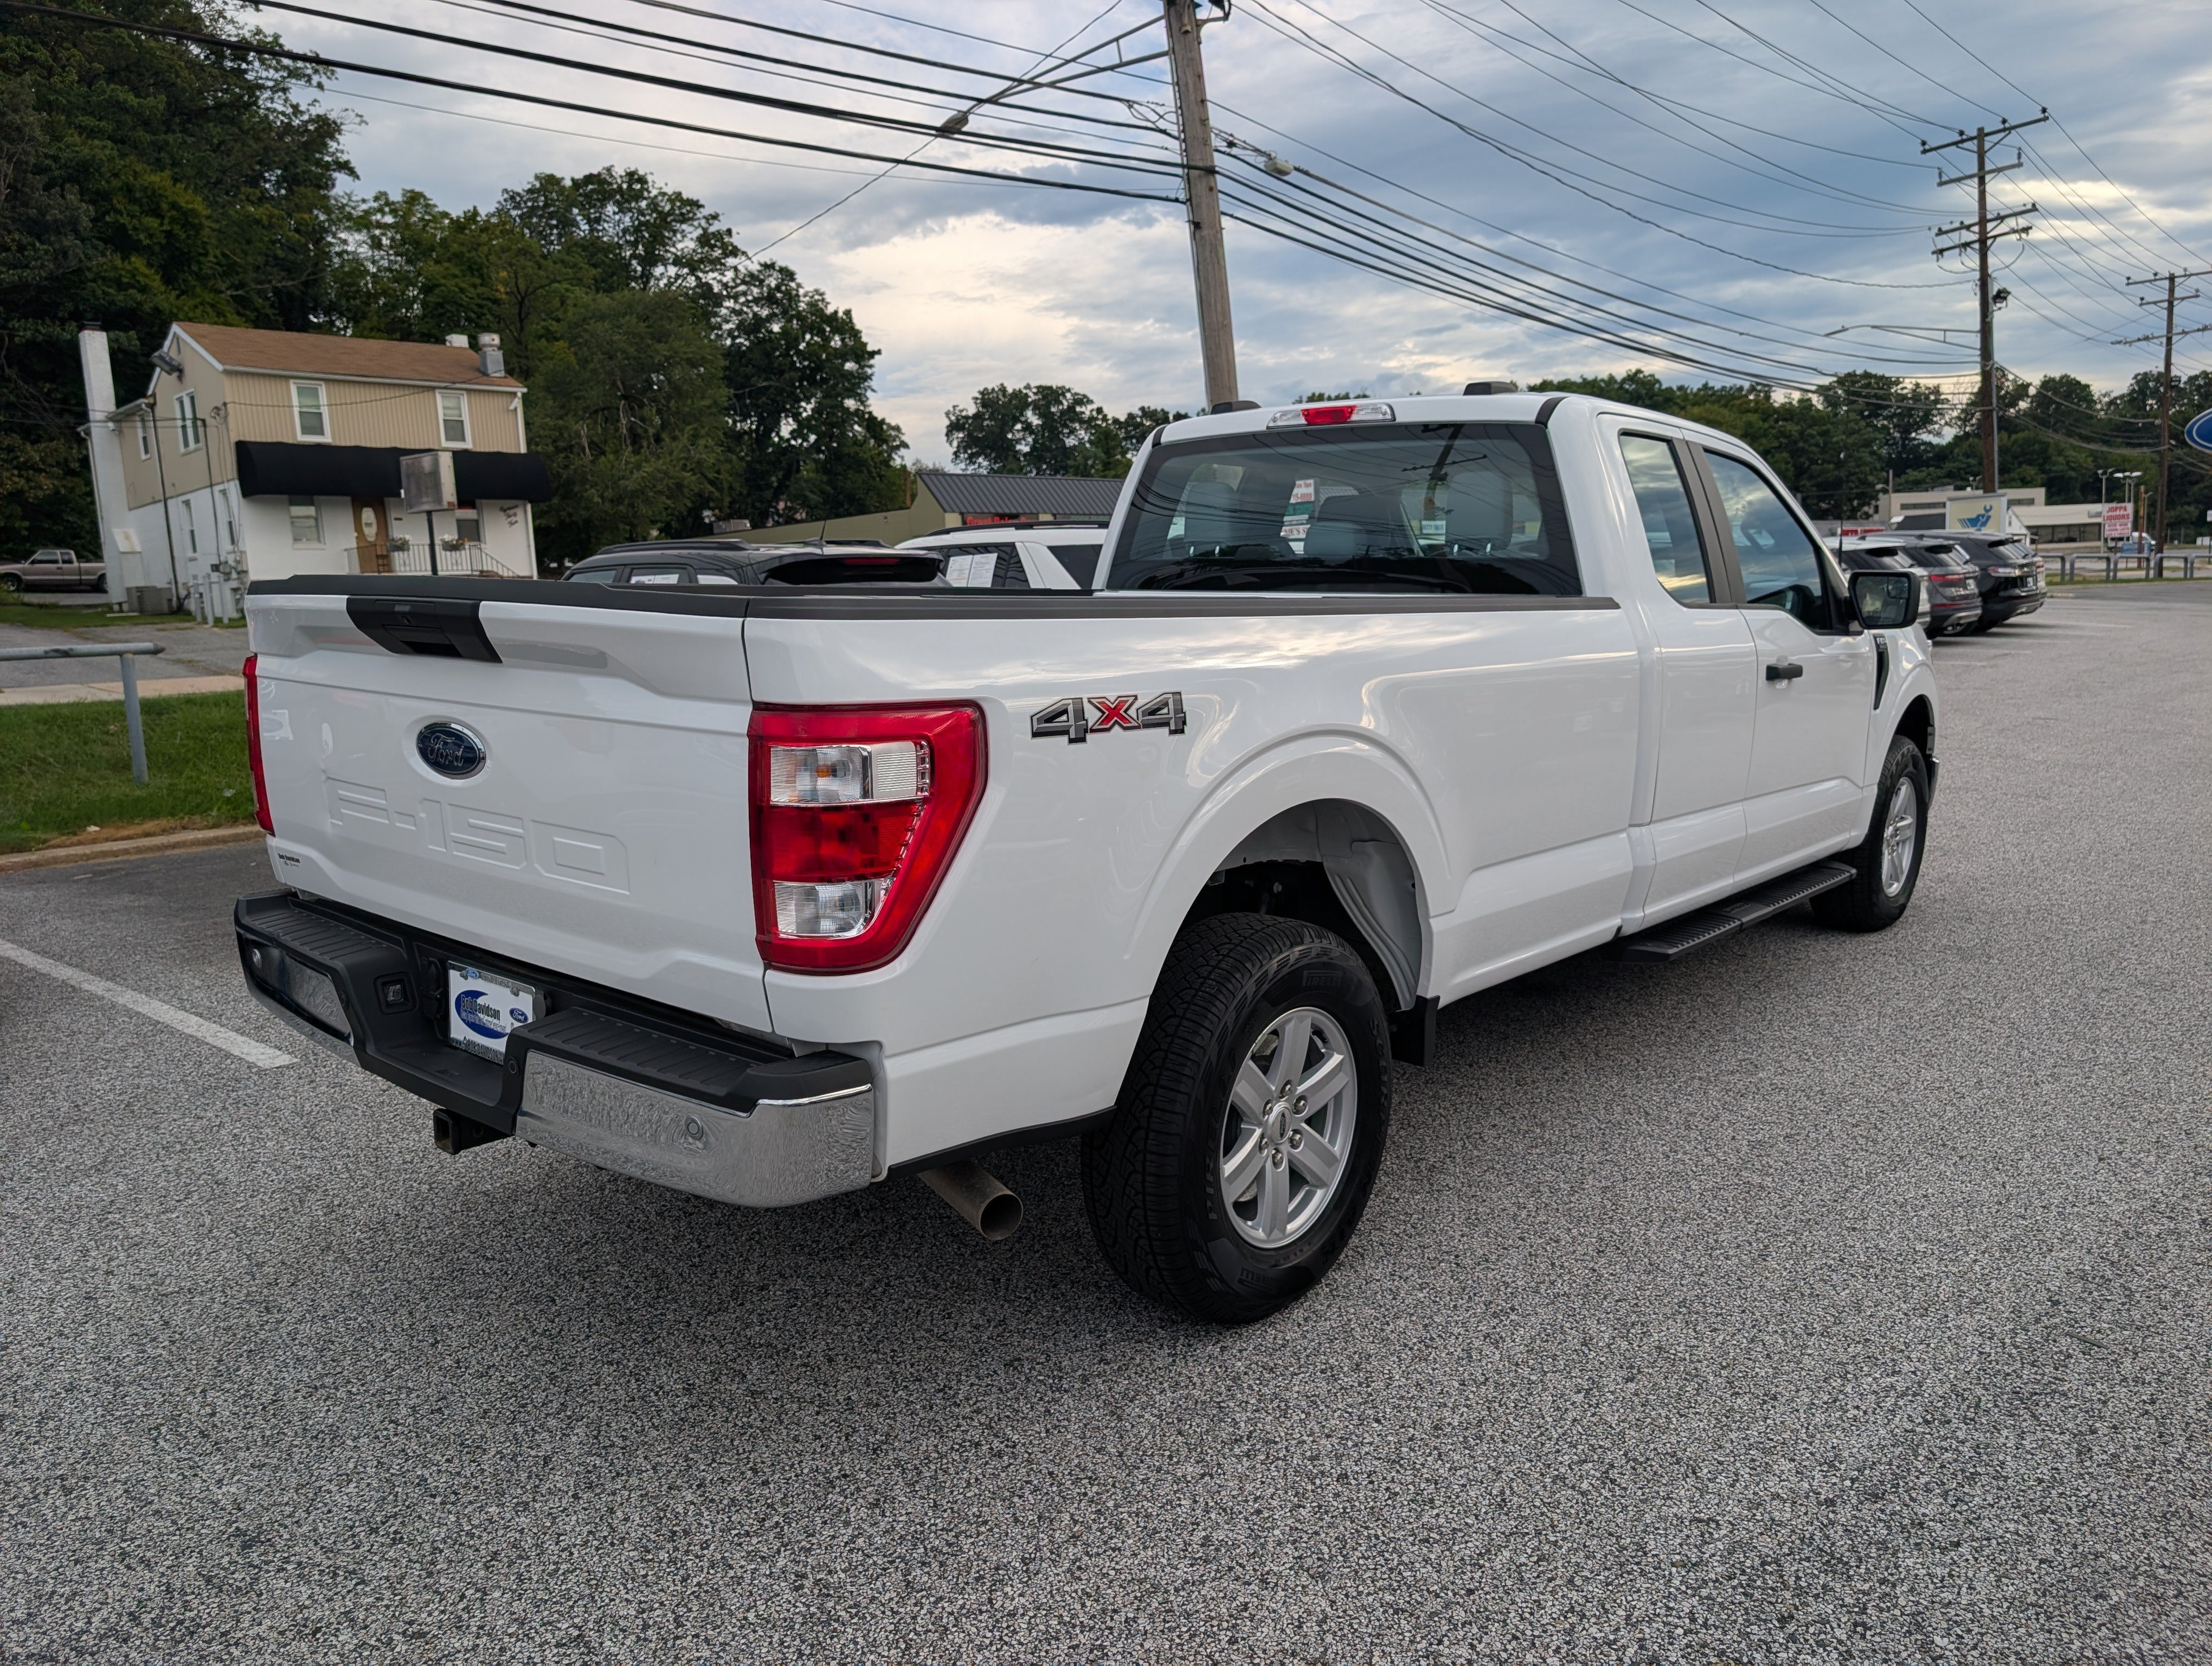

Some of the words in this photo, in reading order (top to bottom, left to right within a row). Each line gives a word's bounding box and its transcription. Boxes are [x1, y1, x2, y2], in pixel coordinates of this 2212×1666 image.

[2102, 512, 2130, 522] LIQUORS
[1030, 690, 1187, 745] 4X4
[427, 733, 465, 767] Ford
[326, 776, 630, 894] F-150
[461, 994, 473, 1010] Bob
[473, 998, 500, 1021] Davidson
[512, 1009, 525, 1022] Ford
